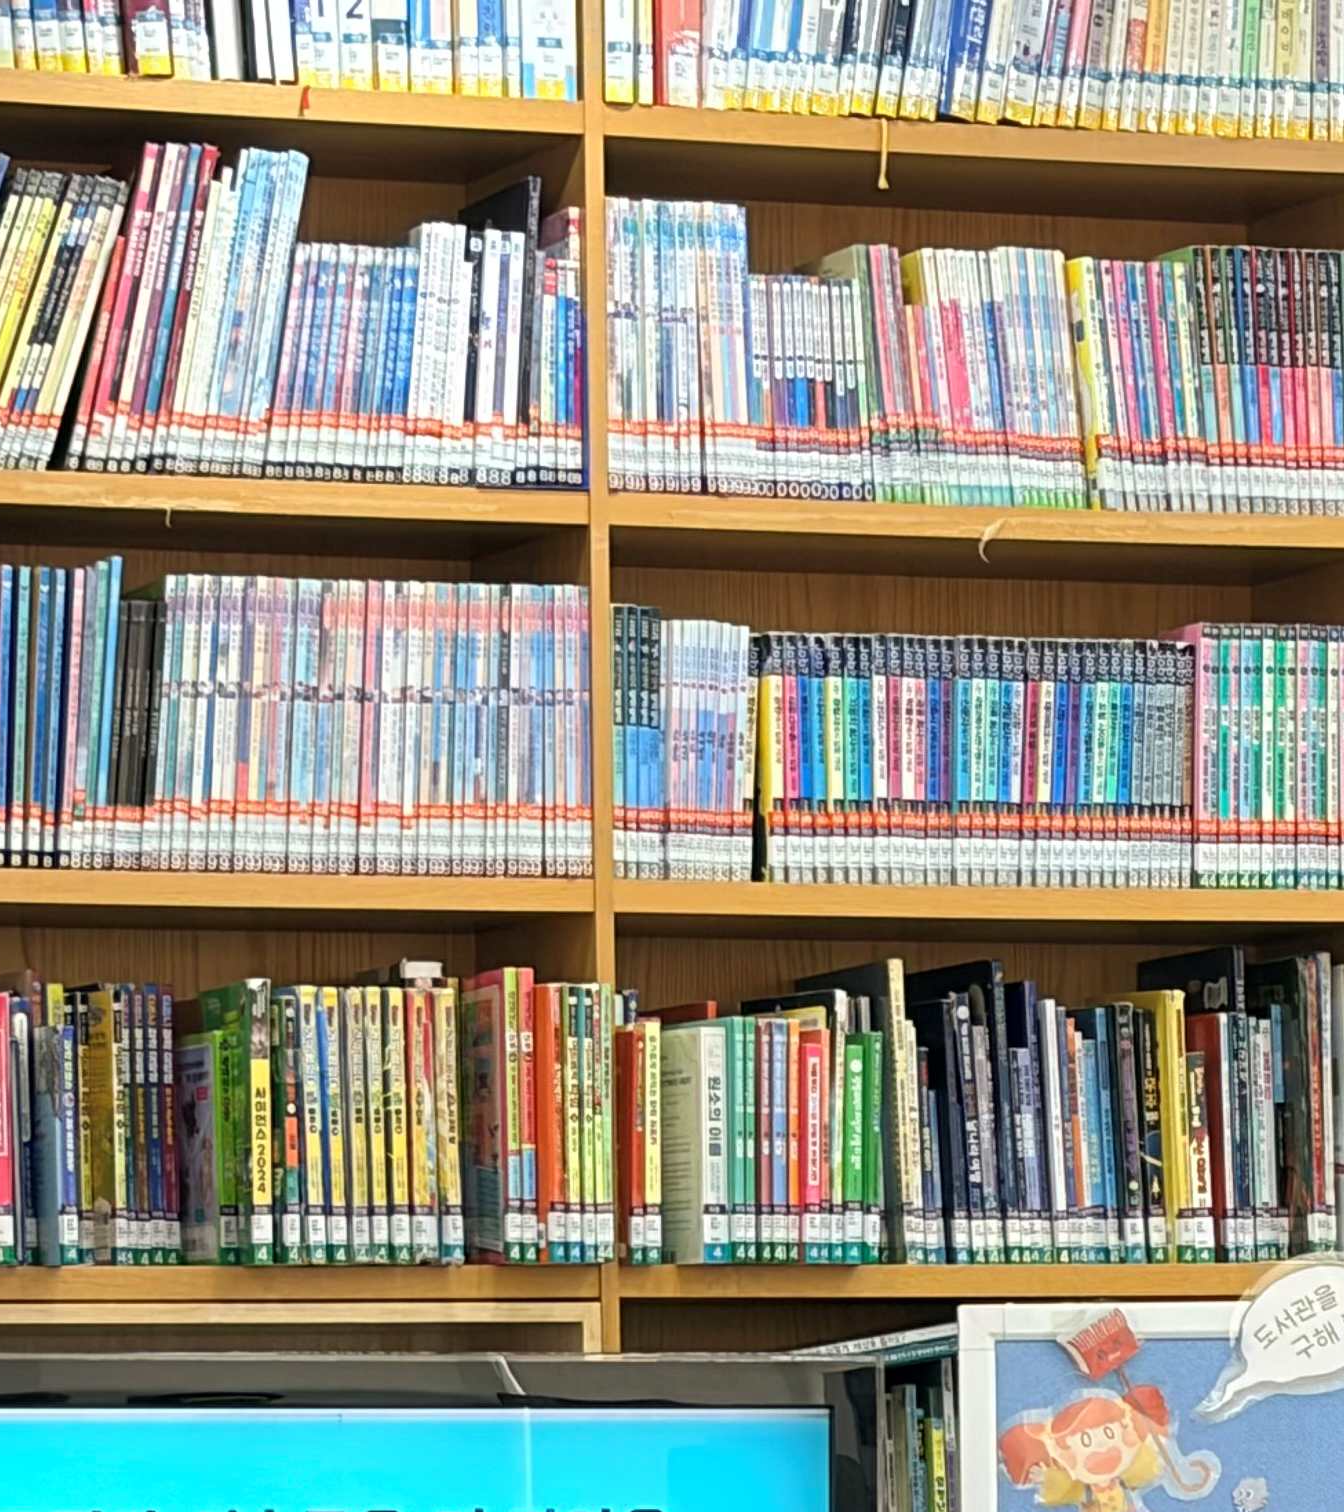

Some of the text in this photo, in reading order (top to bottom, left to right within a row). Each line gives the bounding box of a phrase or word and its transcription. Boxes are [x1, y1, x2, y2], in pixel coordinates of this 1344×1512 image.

[257, 1144, 268, 1193] 2024
[1254, 1284, 1339, 1350] 도서관을
[1290, 1321, 1341, 1360] 구해
